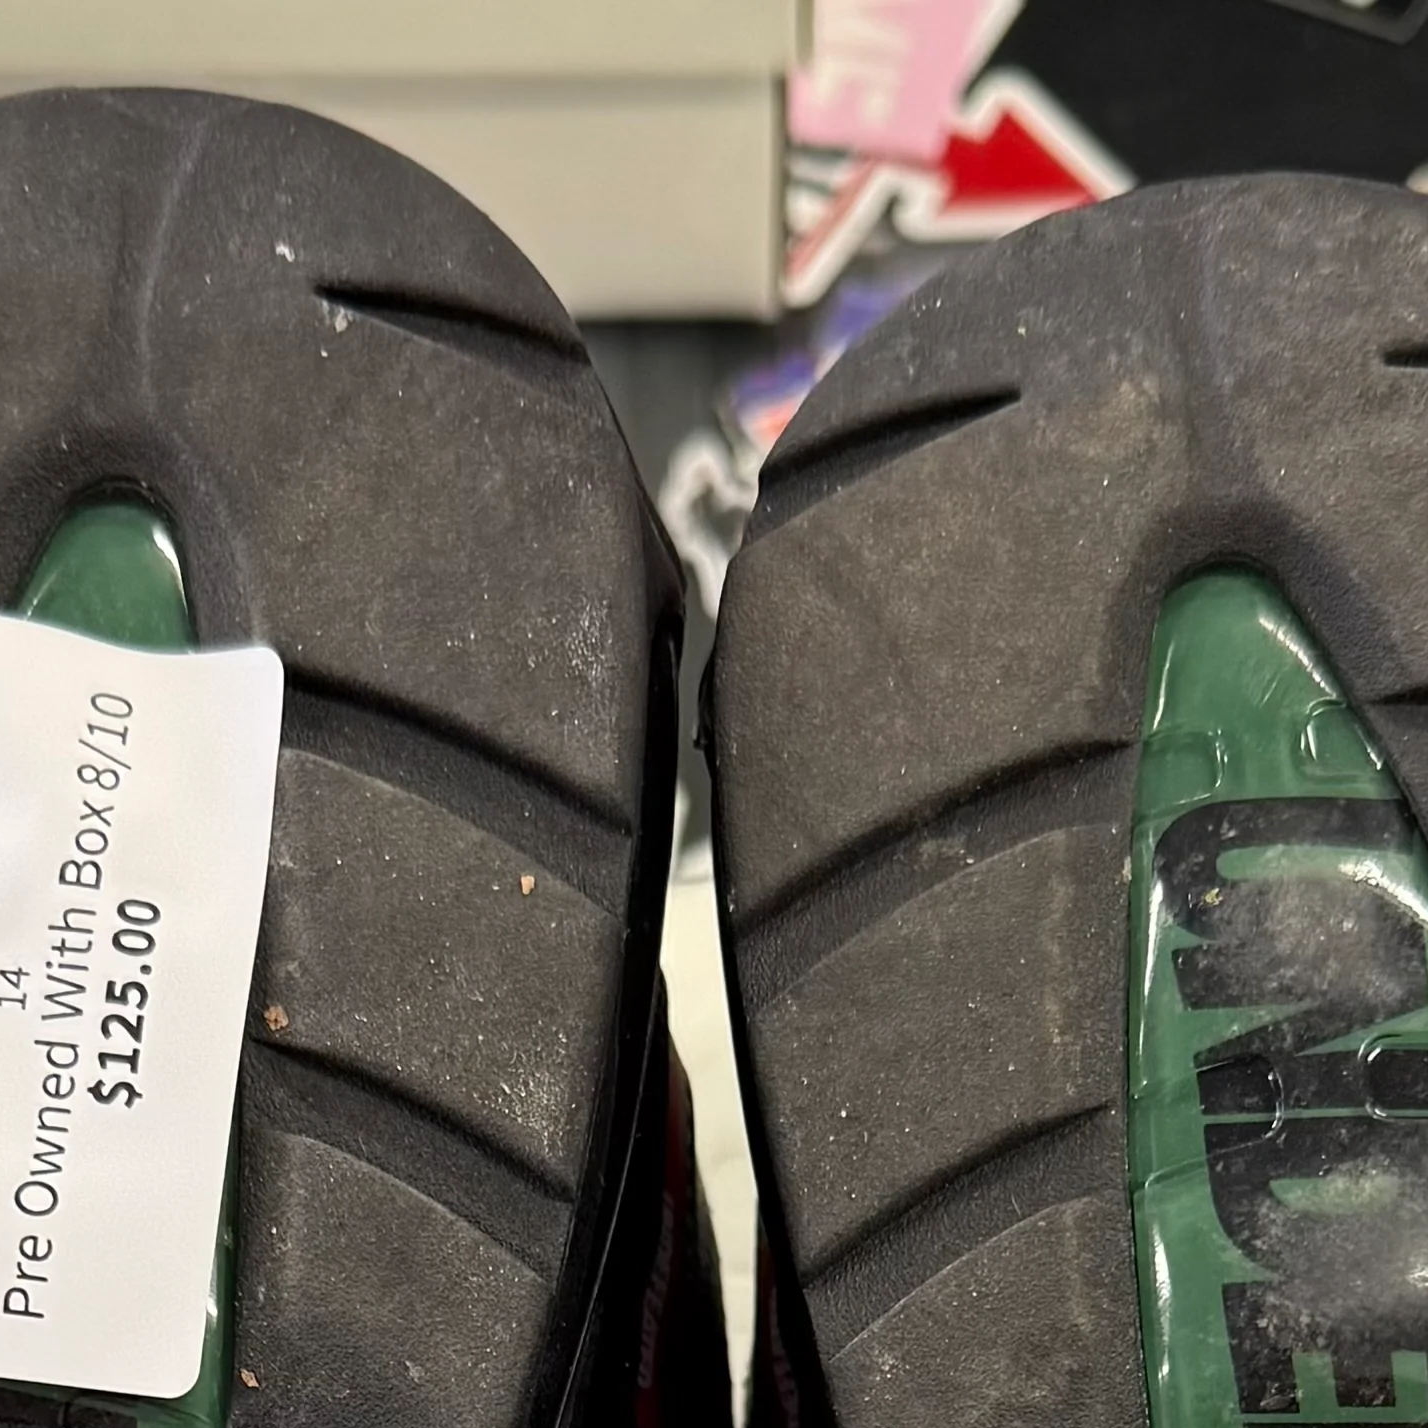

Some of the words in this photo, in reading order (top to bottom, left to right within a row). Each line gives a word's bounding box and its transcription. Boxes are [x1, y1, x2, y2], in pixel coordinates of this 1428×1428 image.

[76, 690, 136, 794] 8/10
[58, 801, 115, 893] Box
[41, 906, 98, 1021] With
[87, 897, 164, 1110] $125.00
[13, 1036, 82, 1219] Owned
[3, 1233, 56, 1322] Pre
